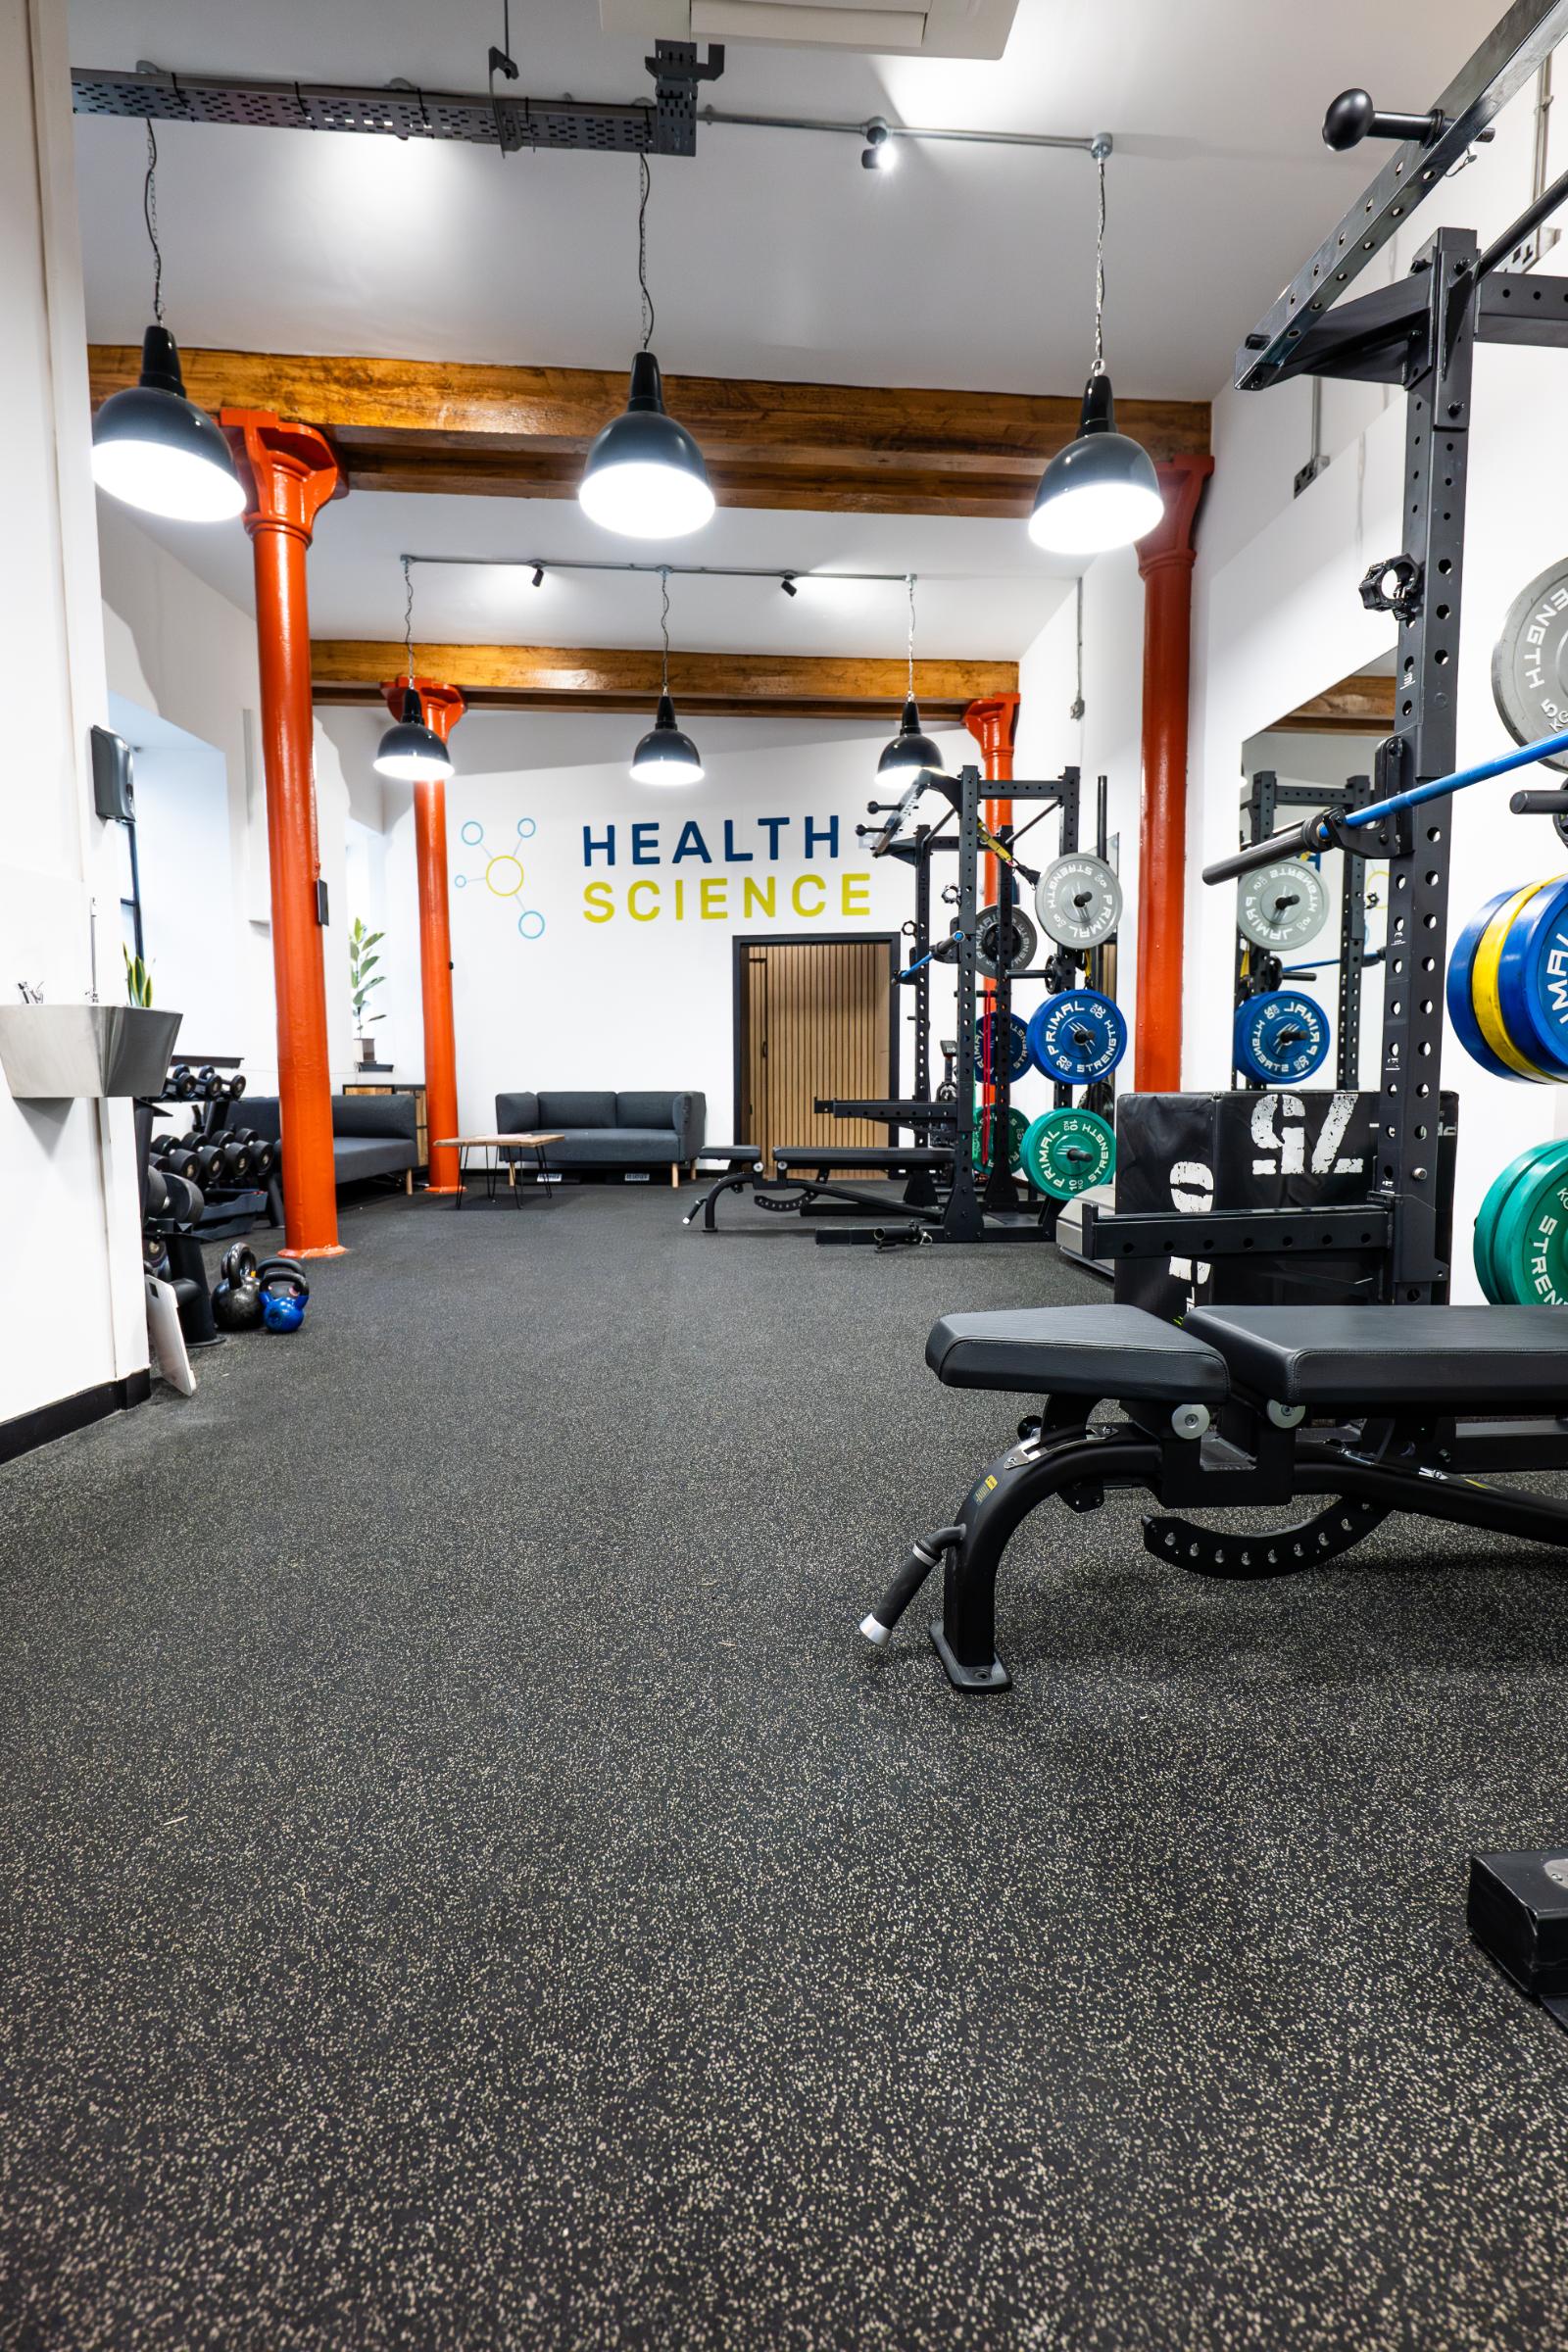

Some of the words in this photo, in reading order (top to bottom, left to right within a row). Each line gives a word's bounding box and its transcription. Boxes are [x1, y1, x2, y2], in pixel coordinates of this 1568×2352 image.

[1541, 699, 1558, 717] 5
[583, 815, 839, 867] HEALTH
[583, 873, 870, 923] SCIENCE
[1047, 863, 1094, 909] STRENGTH
[1068, 894, 1113, 938] PRIMAL
[1045, 1001, 1085, 1055] PRIMAL
[1077, 1019, 1117, 1073] STRENGTH
[1039, 1130, 1065, 1188] PRIMAL
[1082, 1123, 1109, 1183] STRENGTH
[1251, 1094, 1363, 1175] 75
